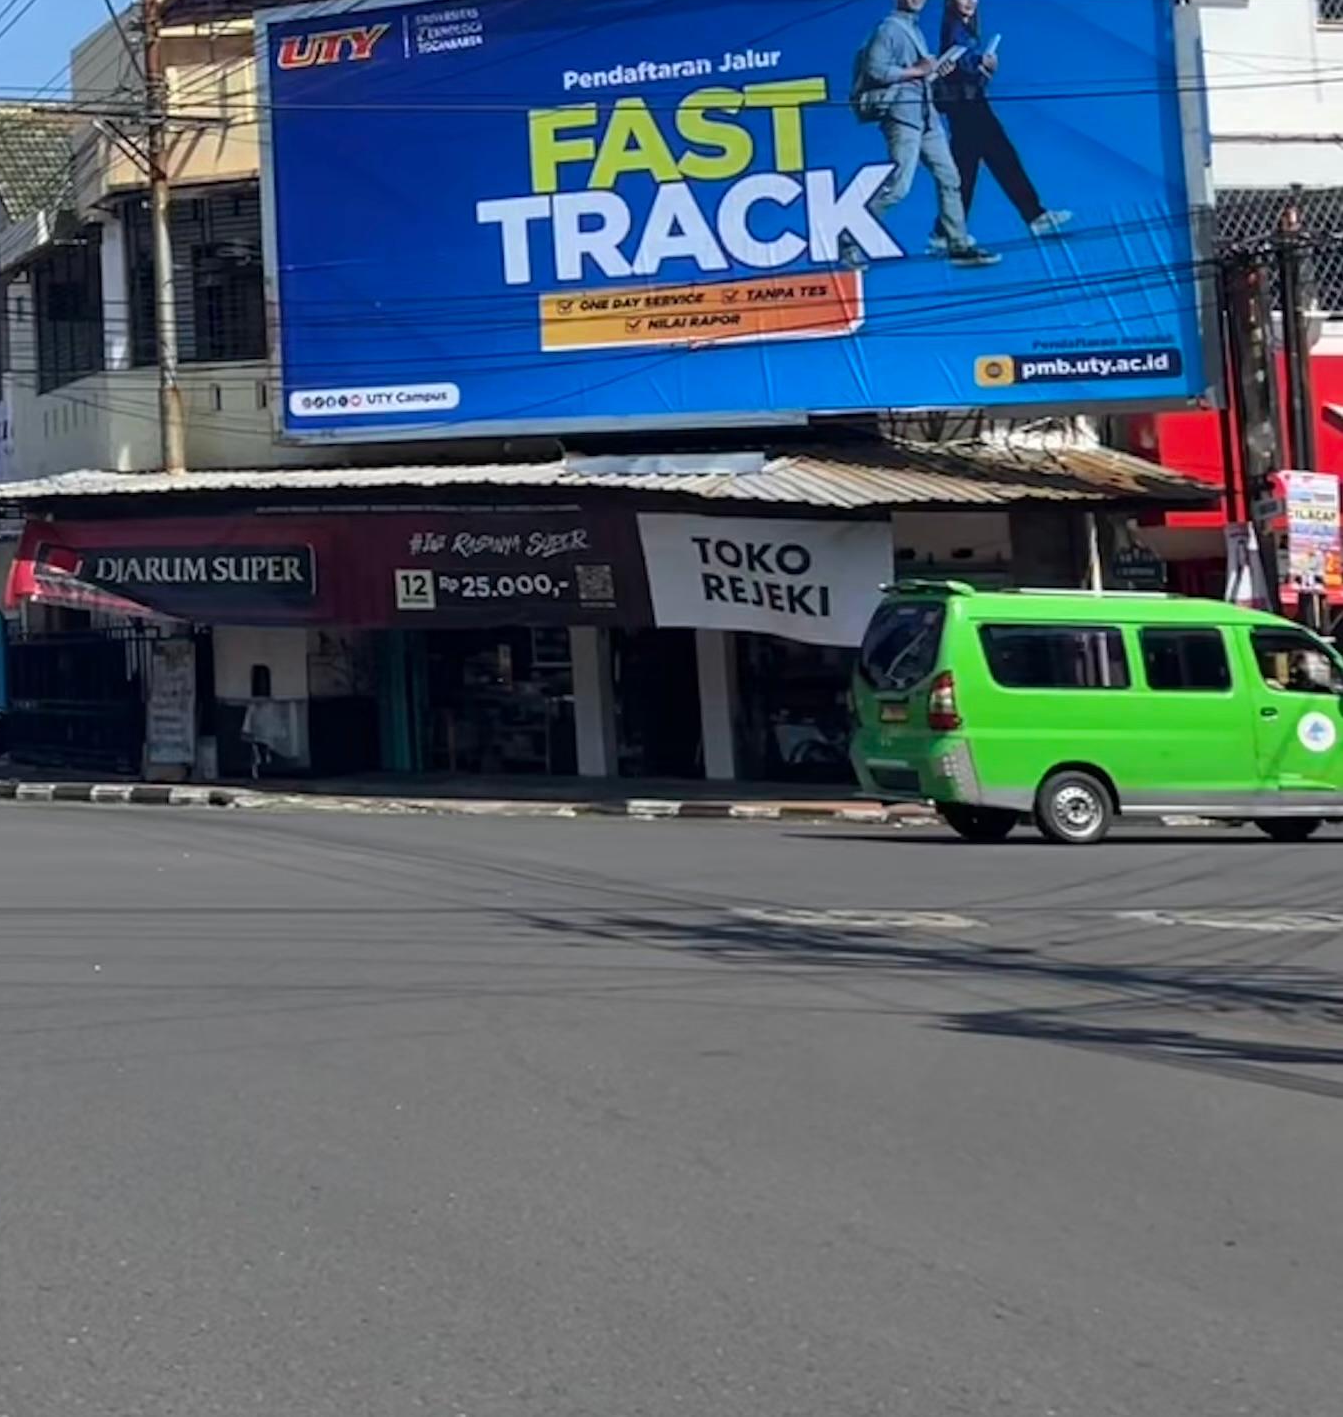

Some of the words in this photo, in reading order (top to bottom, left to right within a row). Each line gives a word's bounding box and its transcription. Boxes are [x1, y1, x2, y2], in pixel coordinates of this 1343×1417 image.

[277, 23, 392, 70] UTY
[563, 58, 711, 90] Pendaftaran
[718, 49, 781, 74] Jalur
[527, 77, 828, 194] FAST
[476, 163, 905, 285] TRACK
[580, 300, 609, 311] ONE
[613, 299, 640, 310] DAY
[644, 293, 705, 308] SERVICE
[747, 289, 794, 302] TANPA
[801, 286, 827, 299] TES
[648, 318, 687, 330] NILAI
[690, 315, 740, 327] RAPOR
[1022, 352, 1169, 379] pmb.uty.ac.id
[367, 392, 392, 404] UTY
[396, 391, 448, 405] Campus
[525, 528, 591, 558] SUPER
[691, 536, 811, 575] TOKO
[95, 556, 208, 582] DJARUM
[212, 556, 304, 582] SUPER
[401, 575, 428, 596] 12
[439, 576, 459, 593] Rp
[462, 573, 570, 598] 25.000,-
[702, 572, 830, 617] REJEKI
